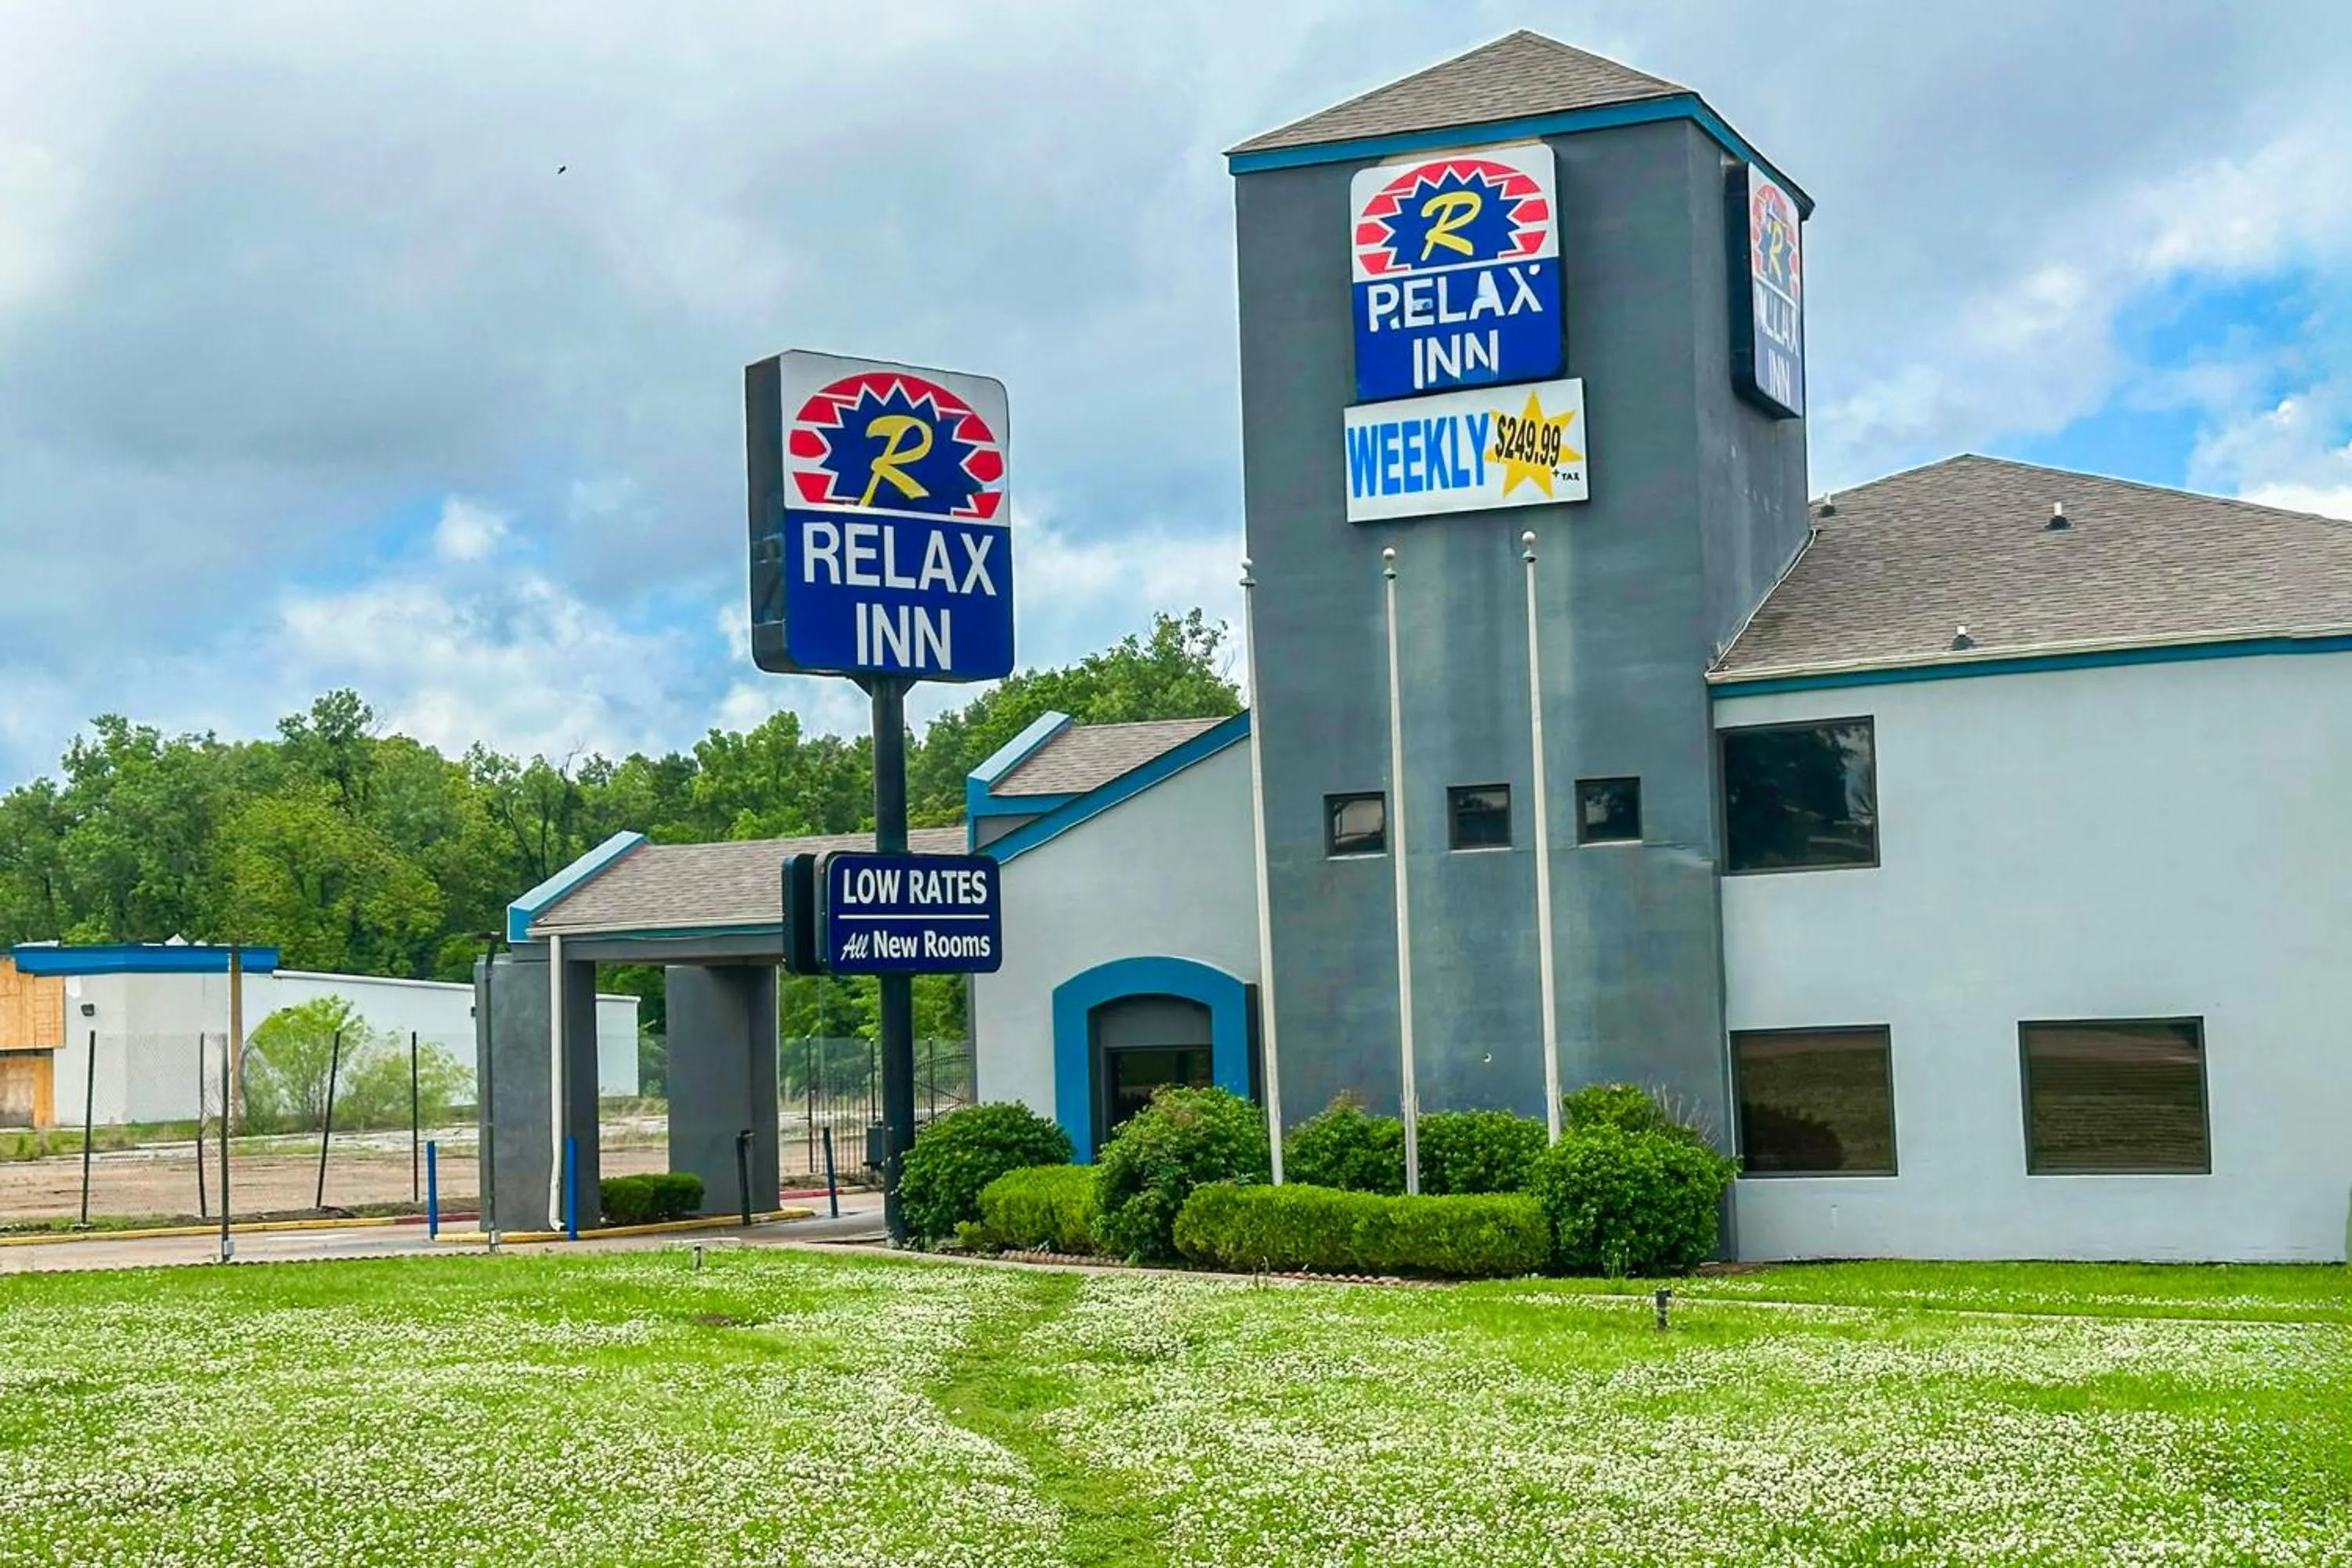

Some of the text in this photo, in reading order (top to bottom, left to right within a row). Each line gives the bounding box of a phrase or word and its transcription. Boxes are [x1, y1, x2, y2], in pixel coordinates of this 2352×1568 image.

[1421, 191, 1483, 261] R
[1367, 265, 1543, 332] RELAX
[1414, 330, 1499, 389] INN
[858, 415, 933, 506] R
[1348, 412, 1562, 498] WEEKLY $249.99
[803, 521, 996, 596] RELAX
[856, 603, 951, 670] INN
[844, 869, 987, 904] LOW RATES
[840, 931, 990, 960] All New Rooms
